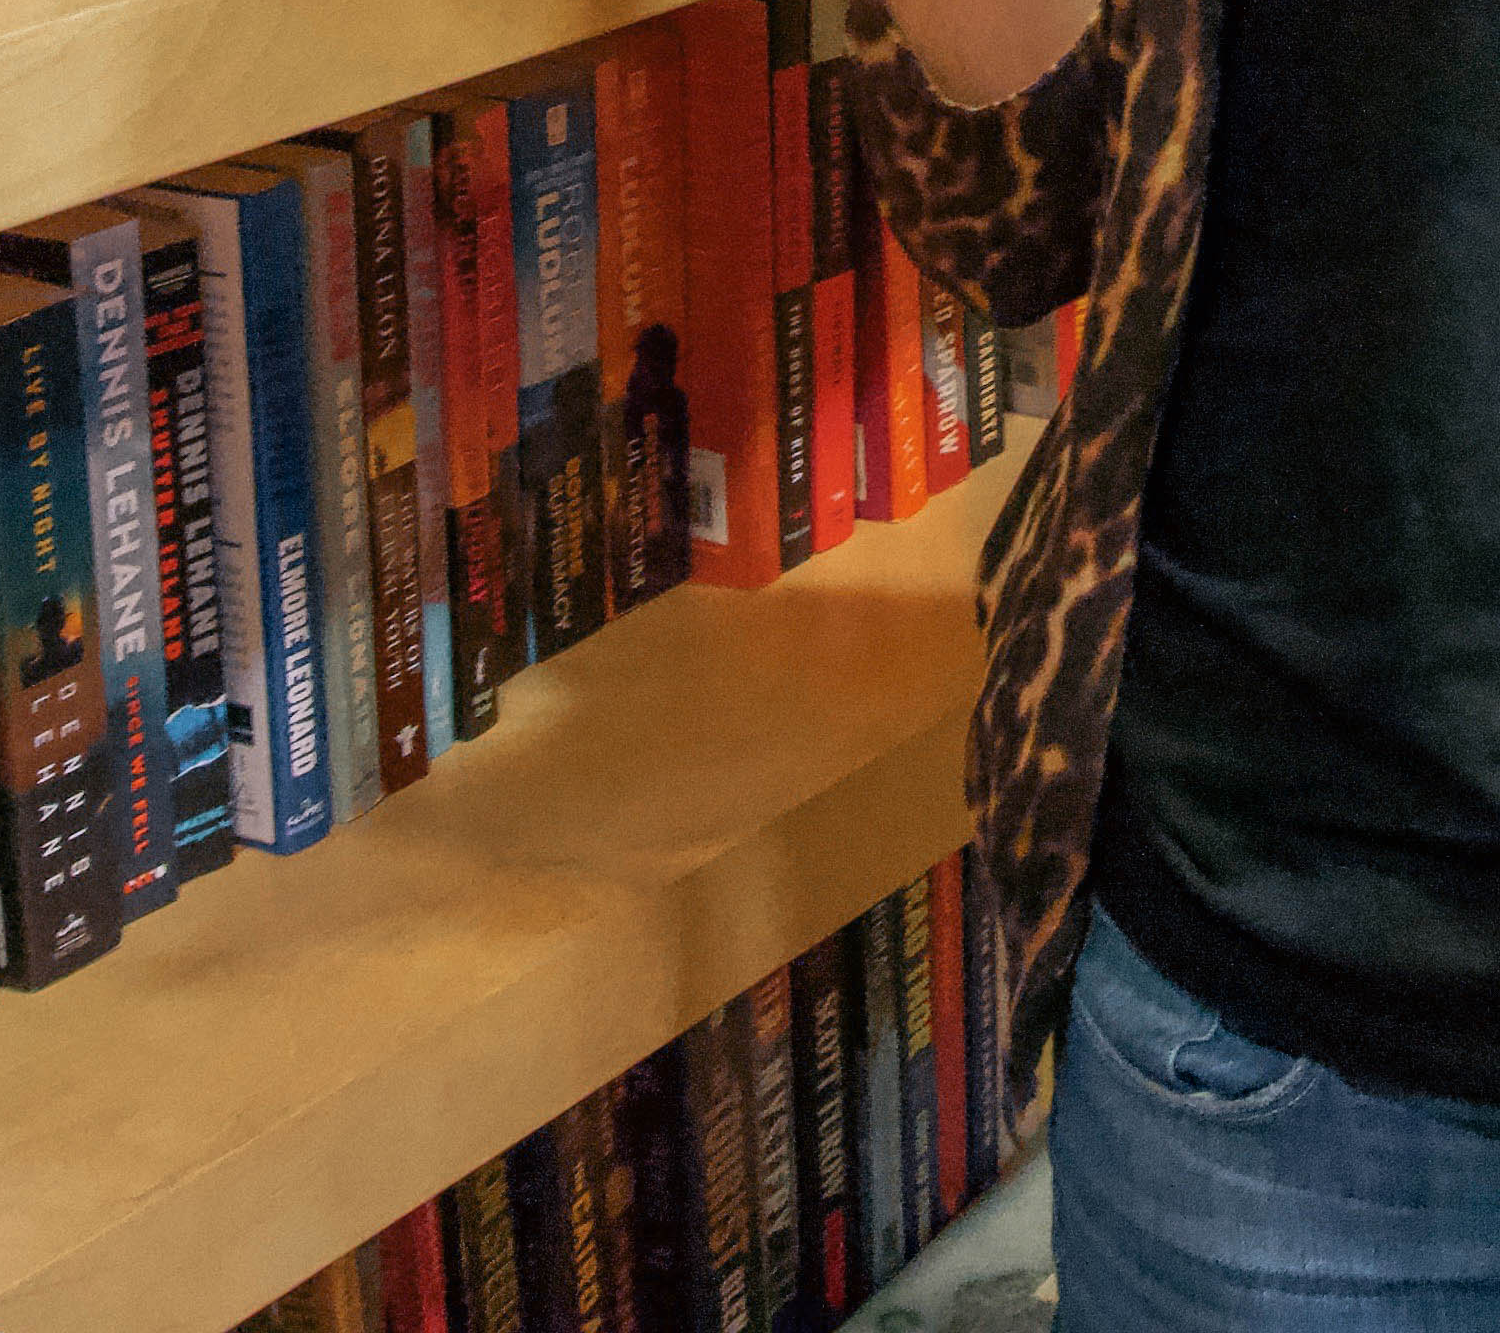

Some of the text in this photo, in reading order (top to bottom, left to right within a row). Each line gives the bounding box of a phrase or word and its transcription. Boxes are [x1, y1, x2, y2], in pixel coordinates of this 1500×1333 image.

[935, 332, 958, 454] SPARROW
[978, 330, 998, 446] CANDIDATE
[277, 535, 320, 780] ELMORE LEONARD
